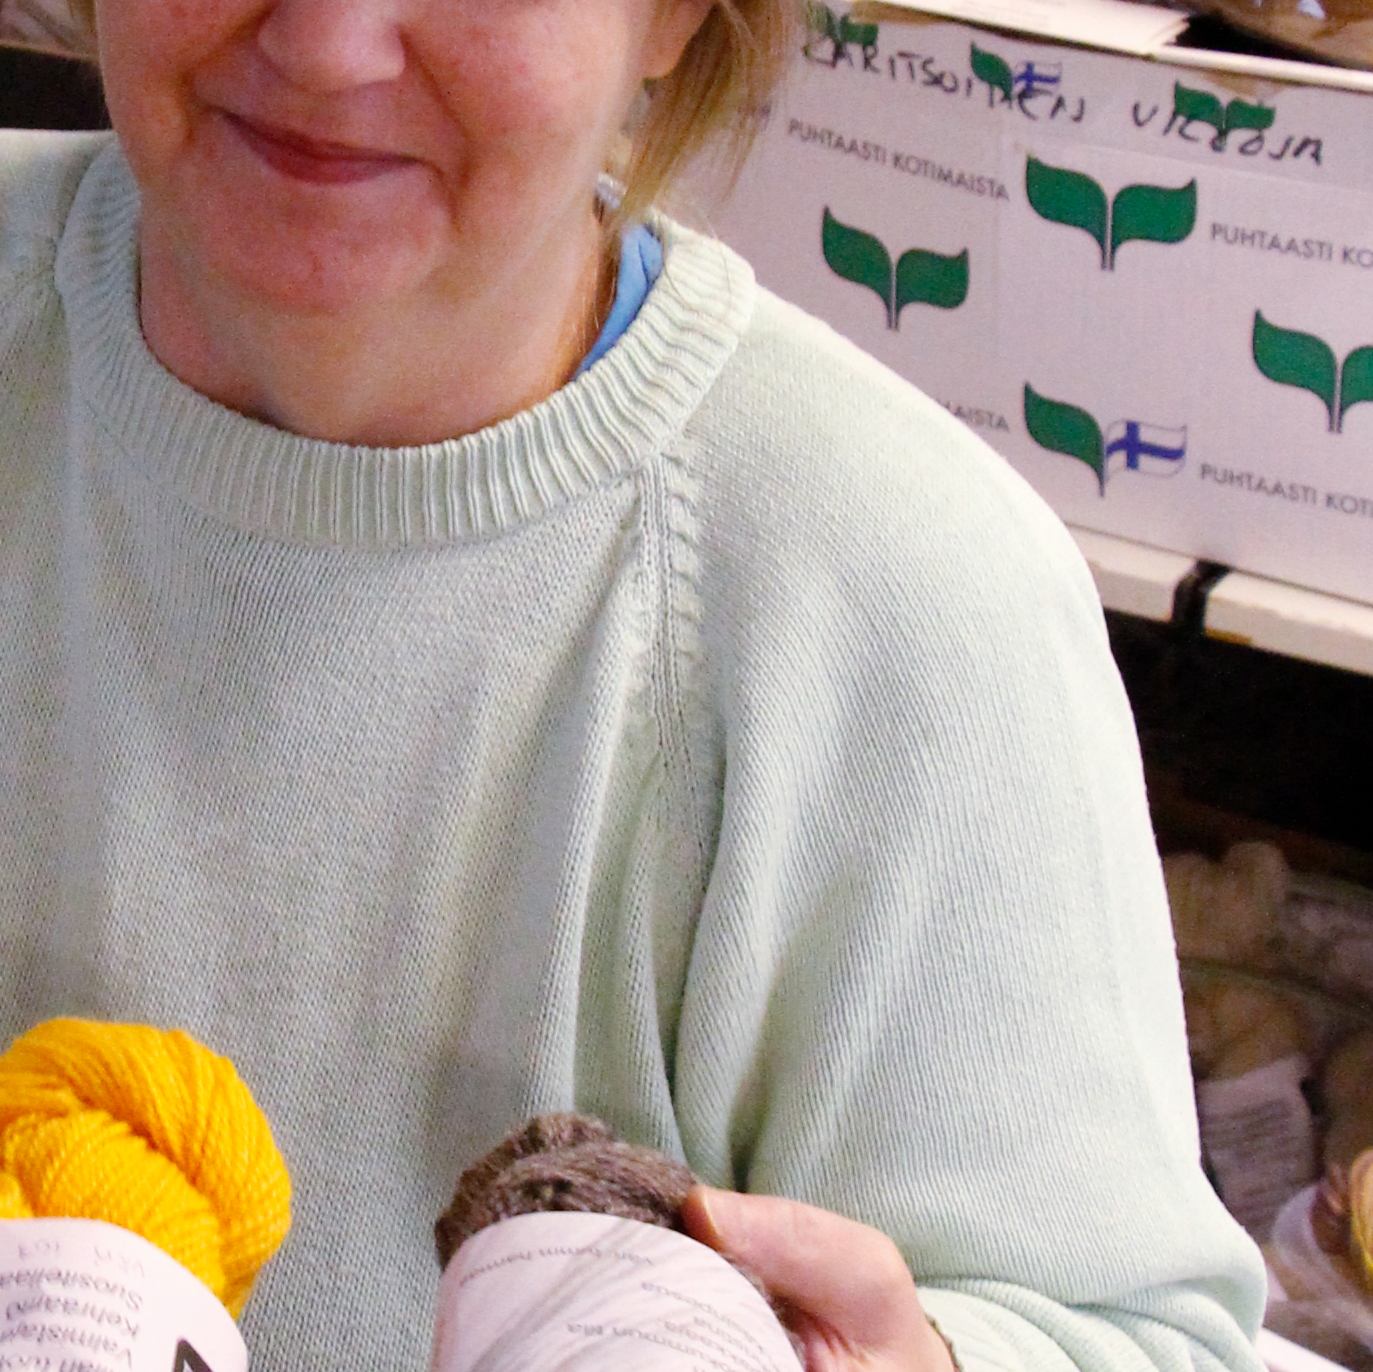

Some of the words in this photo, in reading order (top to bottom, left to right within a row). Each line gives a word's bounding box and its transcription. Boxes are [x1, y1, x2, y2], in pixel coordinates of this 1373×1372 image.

[789, 118, 889, 166] PUHTAASTI
[892, 147, 1010, 203] KOTIMAISTA
[1210, 223, 1333, 263] PUHTAASTI
[1199, 462, 1318, 506] PUHTAASTI
